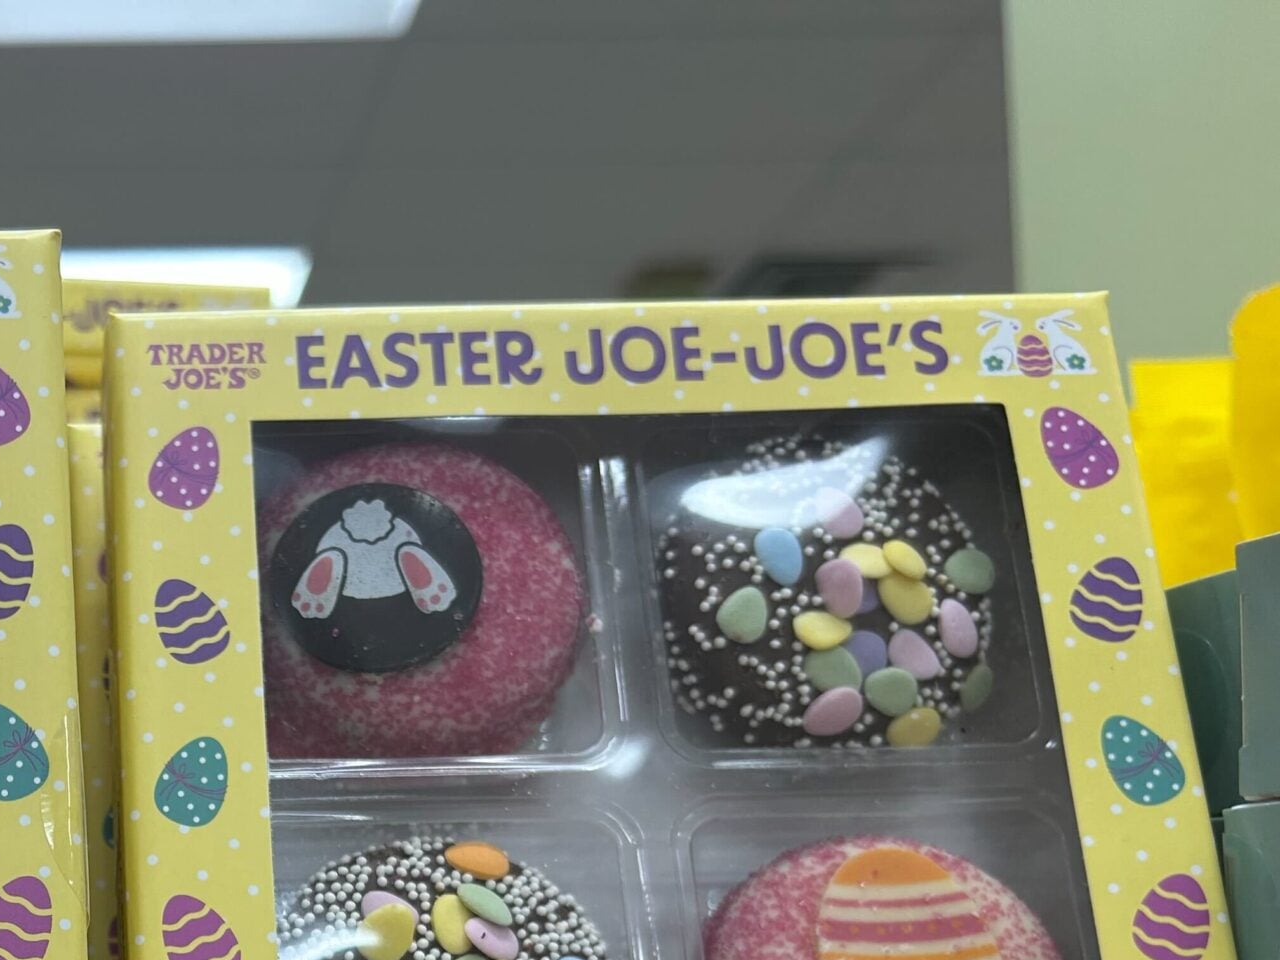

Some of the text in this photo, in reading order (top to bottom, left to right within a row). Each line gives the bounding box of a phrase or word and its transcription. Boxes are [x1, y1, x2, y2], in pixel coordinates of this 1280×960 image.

[146, 342, 266, 365] TRADER
[295, 320, 949, 389] EASTER JOE-JOE'S
